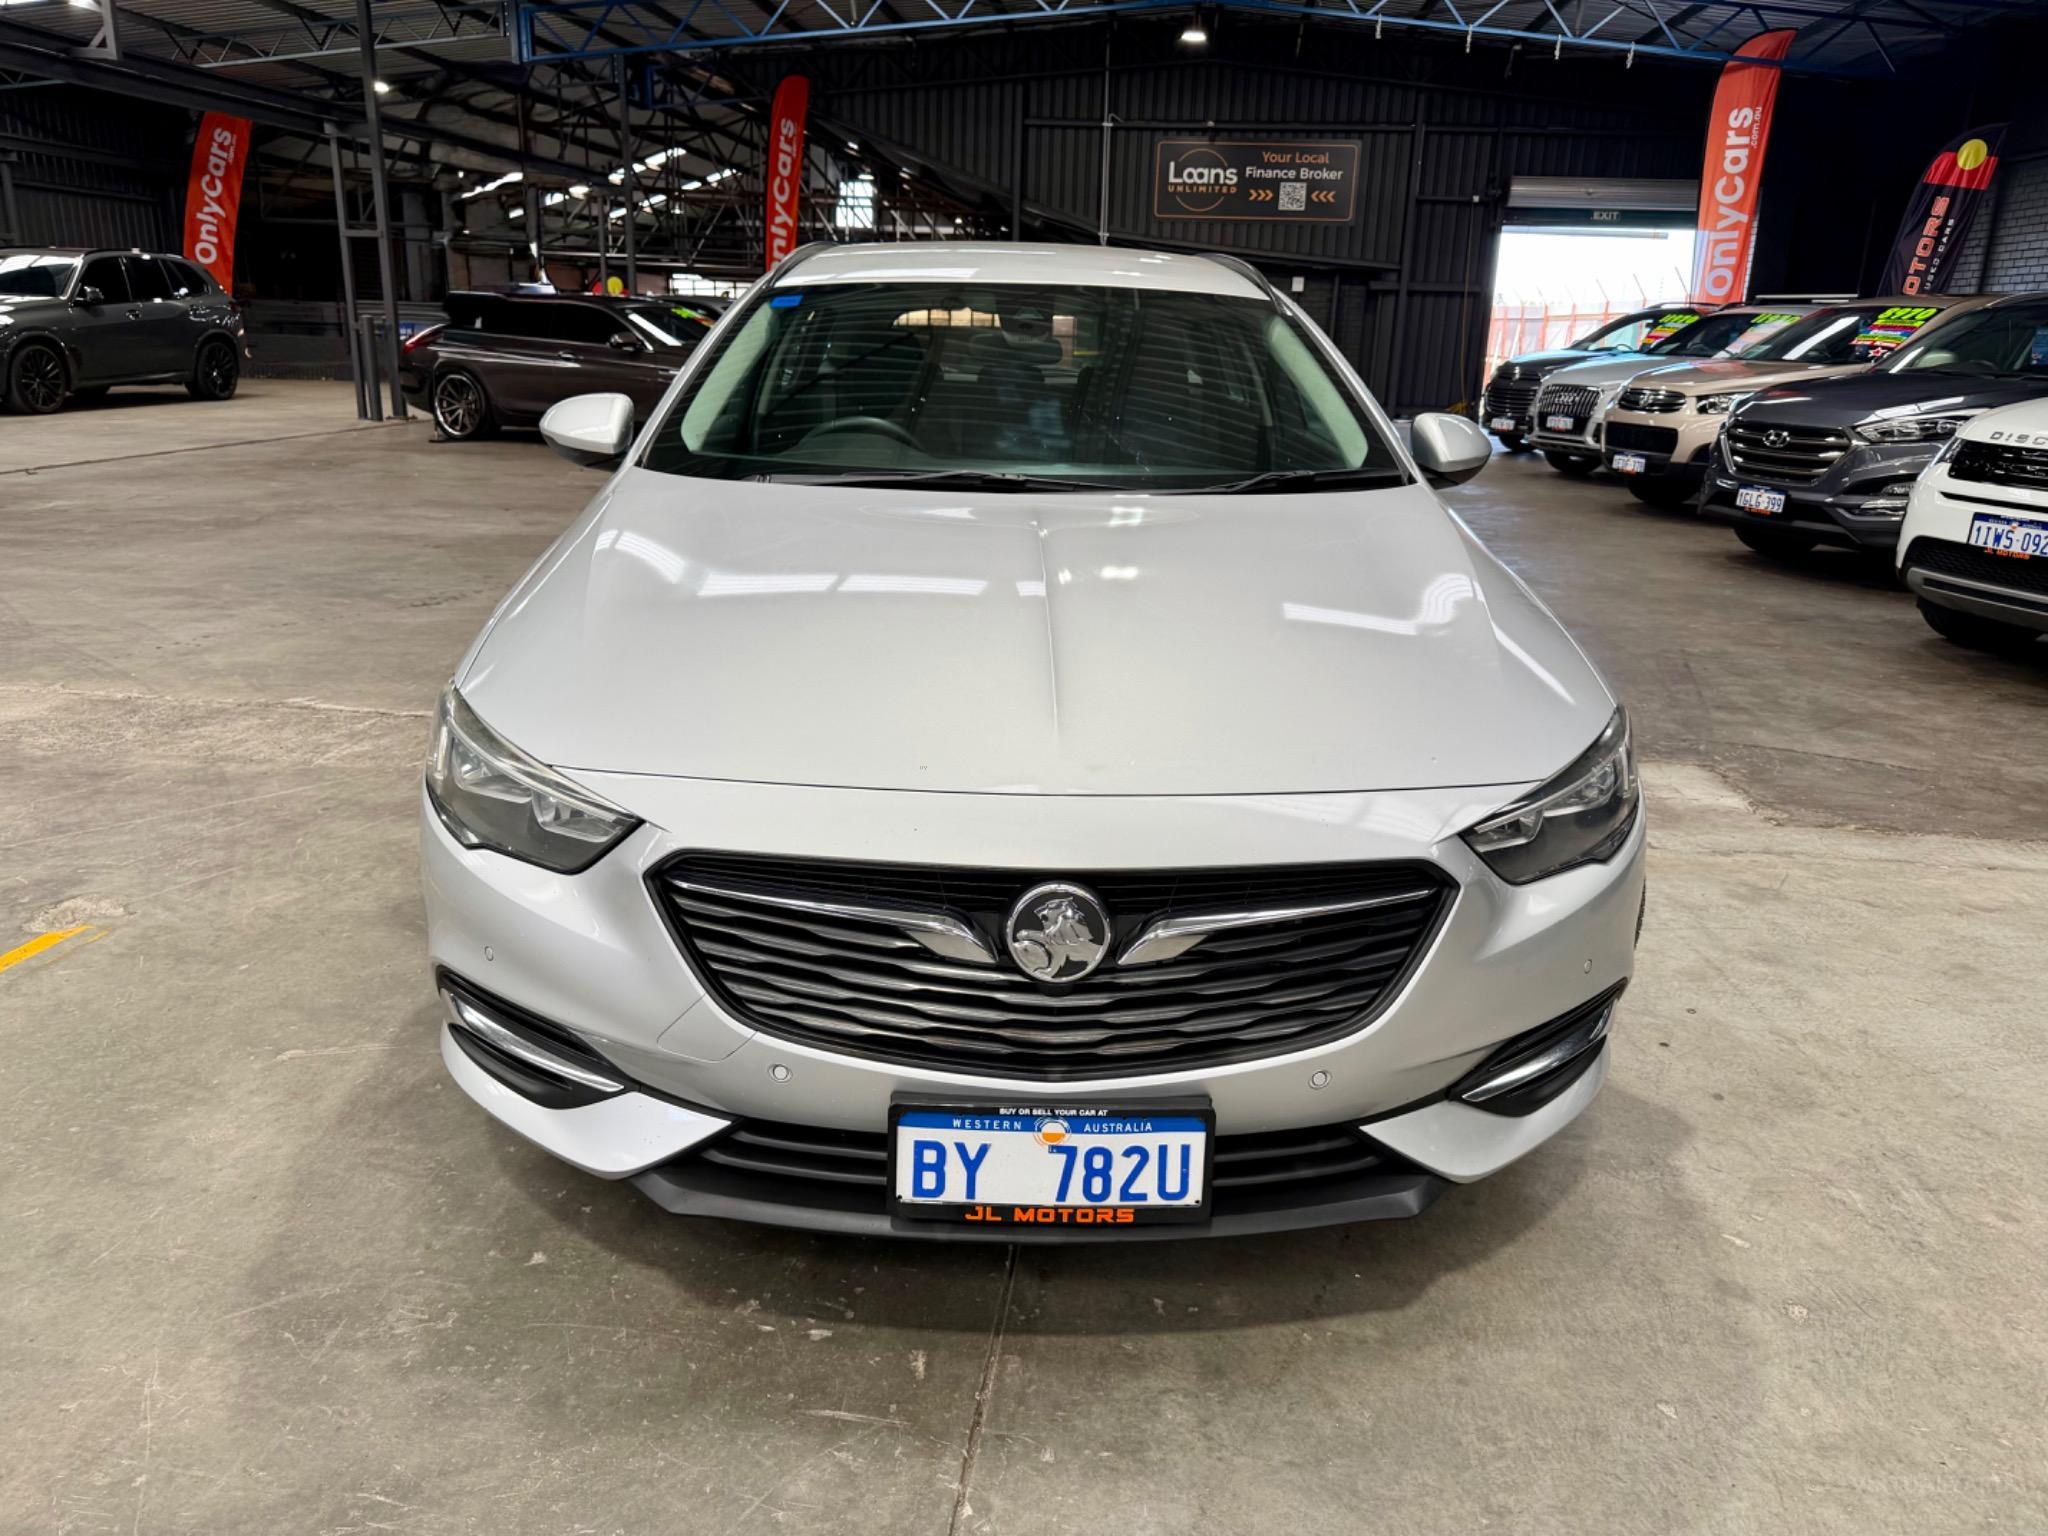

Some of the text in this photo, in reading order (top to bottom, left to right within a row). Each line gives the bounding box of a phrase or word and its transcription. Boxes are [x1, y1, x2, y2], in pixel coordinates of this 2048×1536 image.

[1262, 151, 1329, 164] Your Local
[1168, 160, 1239, 185] Loans
[1245, 166, 1344, 180] Finance Broker
[194, 127, 232, 265] OnlyCars
[771, 118, 795, 270] nlyCars
[1167, 184, 1238, 193] UNLIMITED
[1705, 106, 1754, 297] OnlyCars
[1902, 196, 1950, 296] OTORS
[1032, 1108, 1052, 1116] SELL
[1097, 1109, 1108, 1117] AT
[952, 1118, 1153, 1133] WESTERN AUSTRALIA
[911, 1139, 1191, 1203] BY 782U
[964, 1205, 1136, 1223] JL MOTORS
